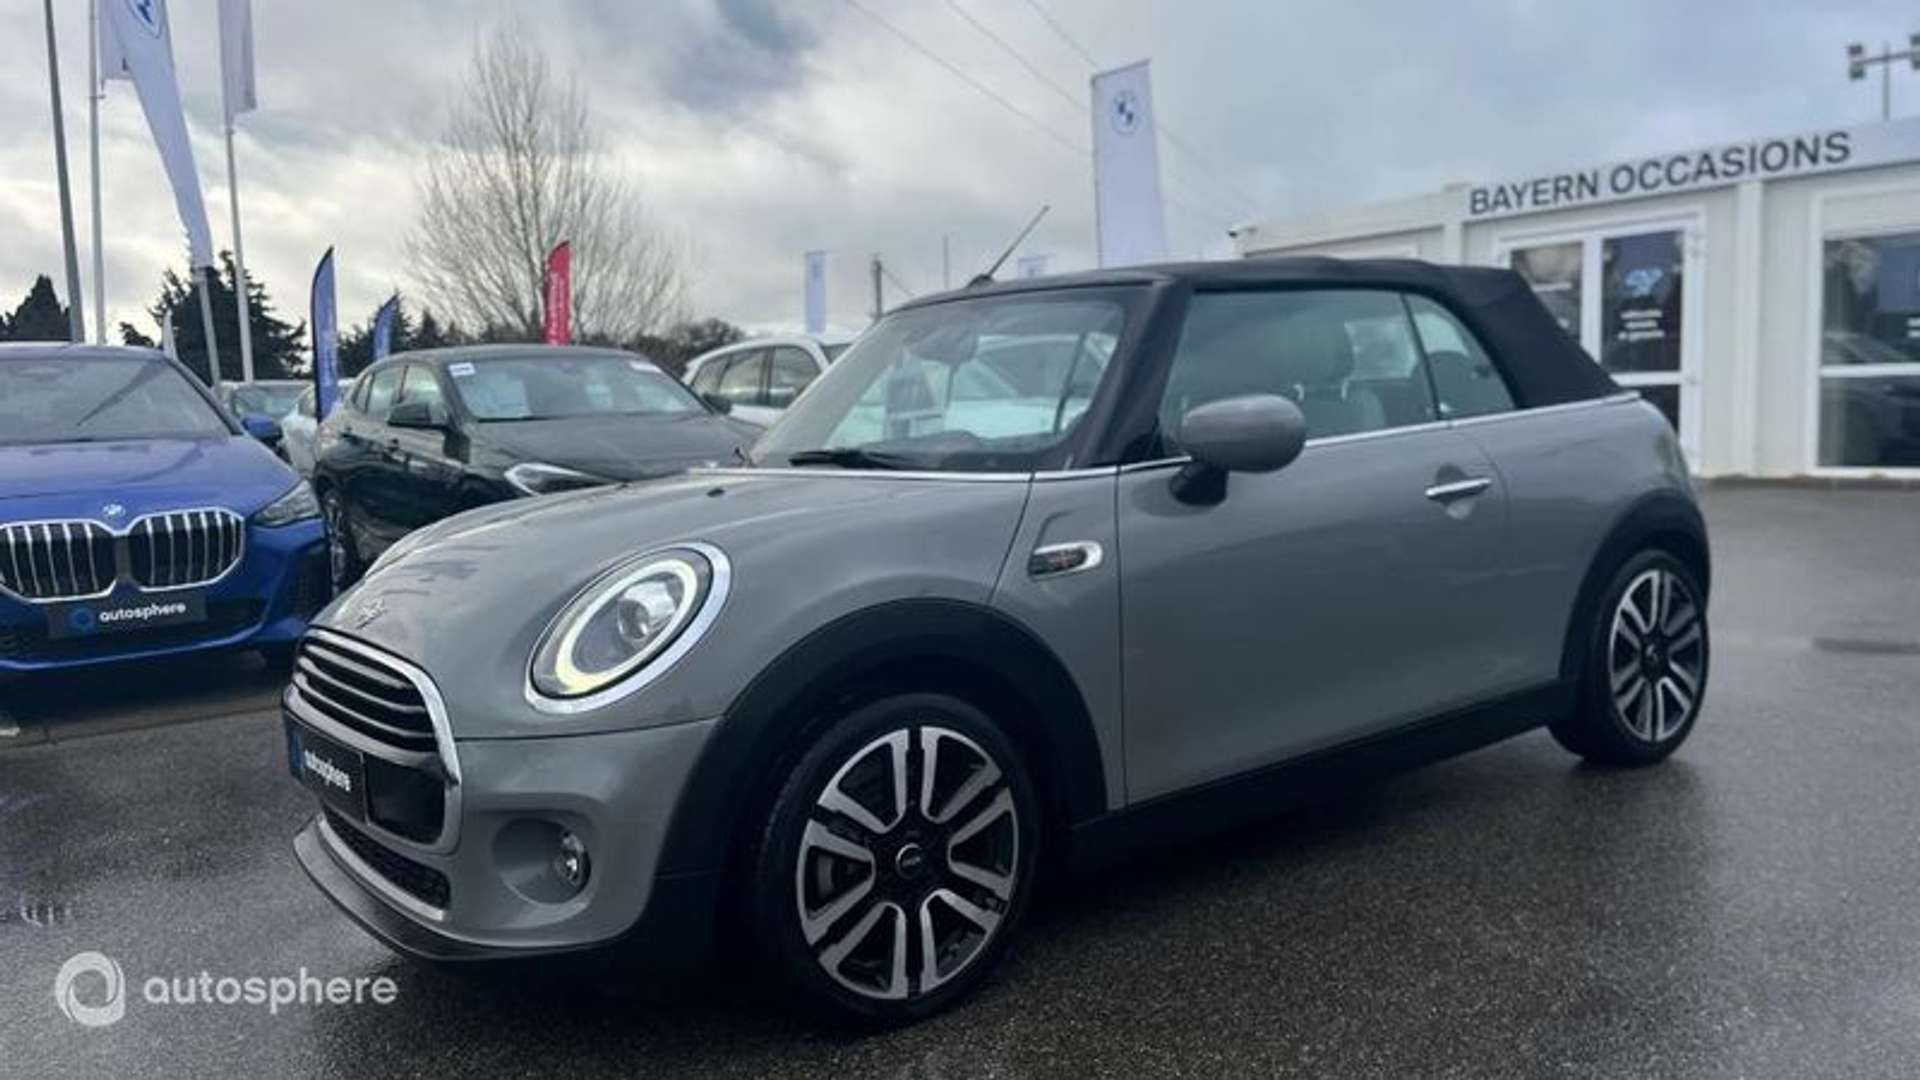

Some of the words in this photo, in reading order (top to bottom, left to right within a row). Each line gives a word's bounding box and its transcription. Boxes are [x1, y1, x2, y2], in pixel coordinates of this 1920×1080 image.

[1470, 170, 1599, 214] BAYERN
[1609, 131, 1851, 195] OCCASIONS
[99, 602, 187, 622] autosphere
